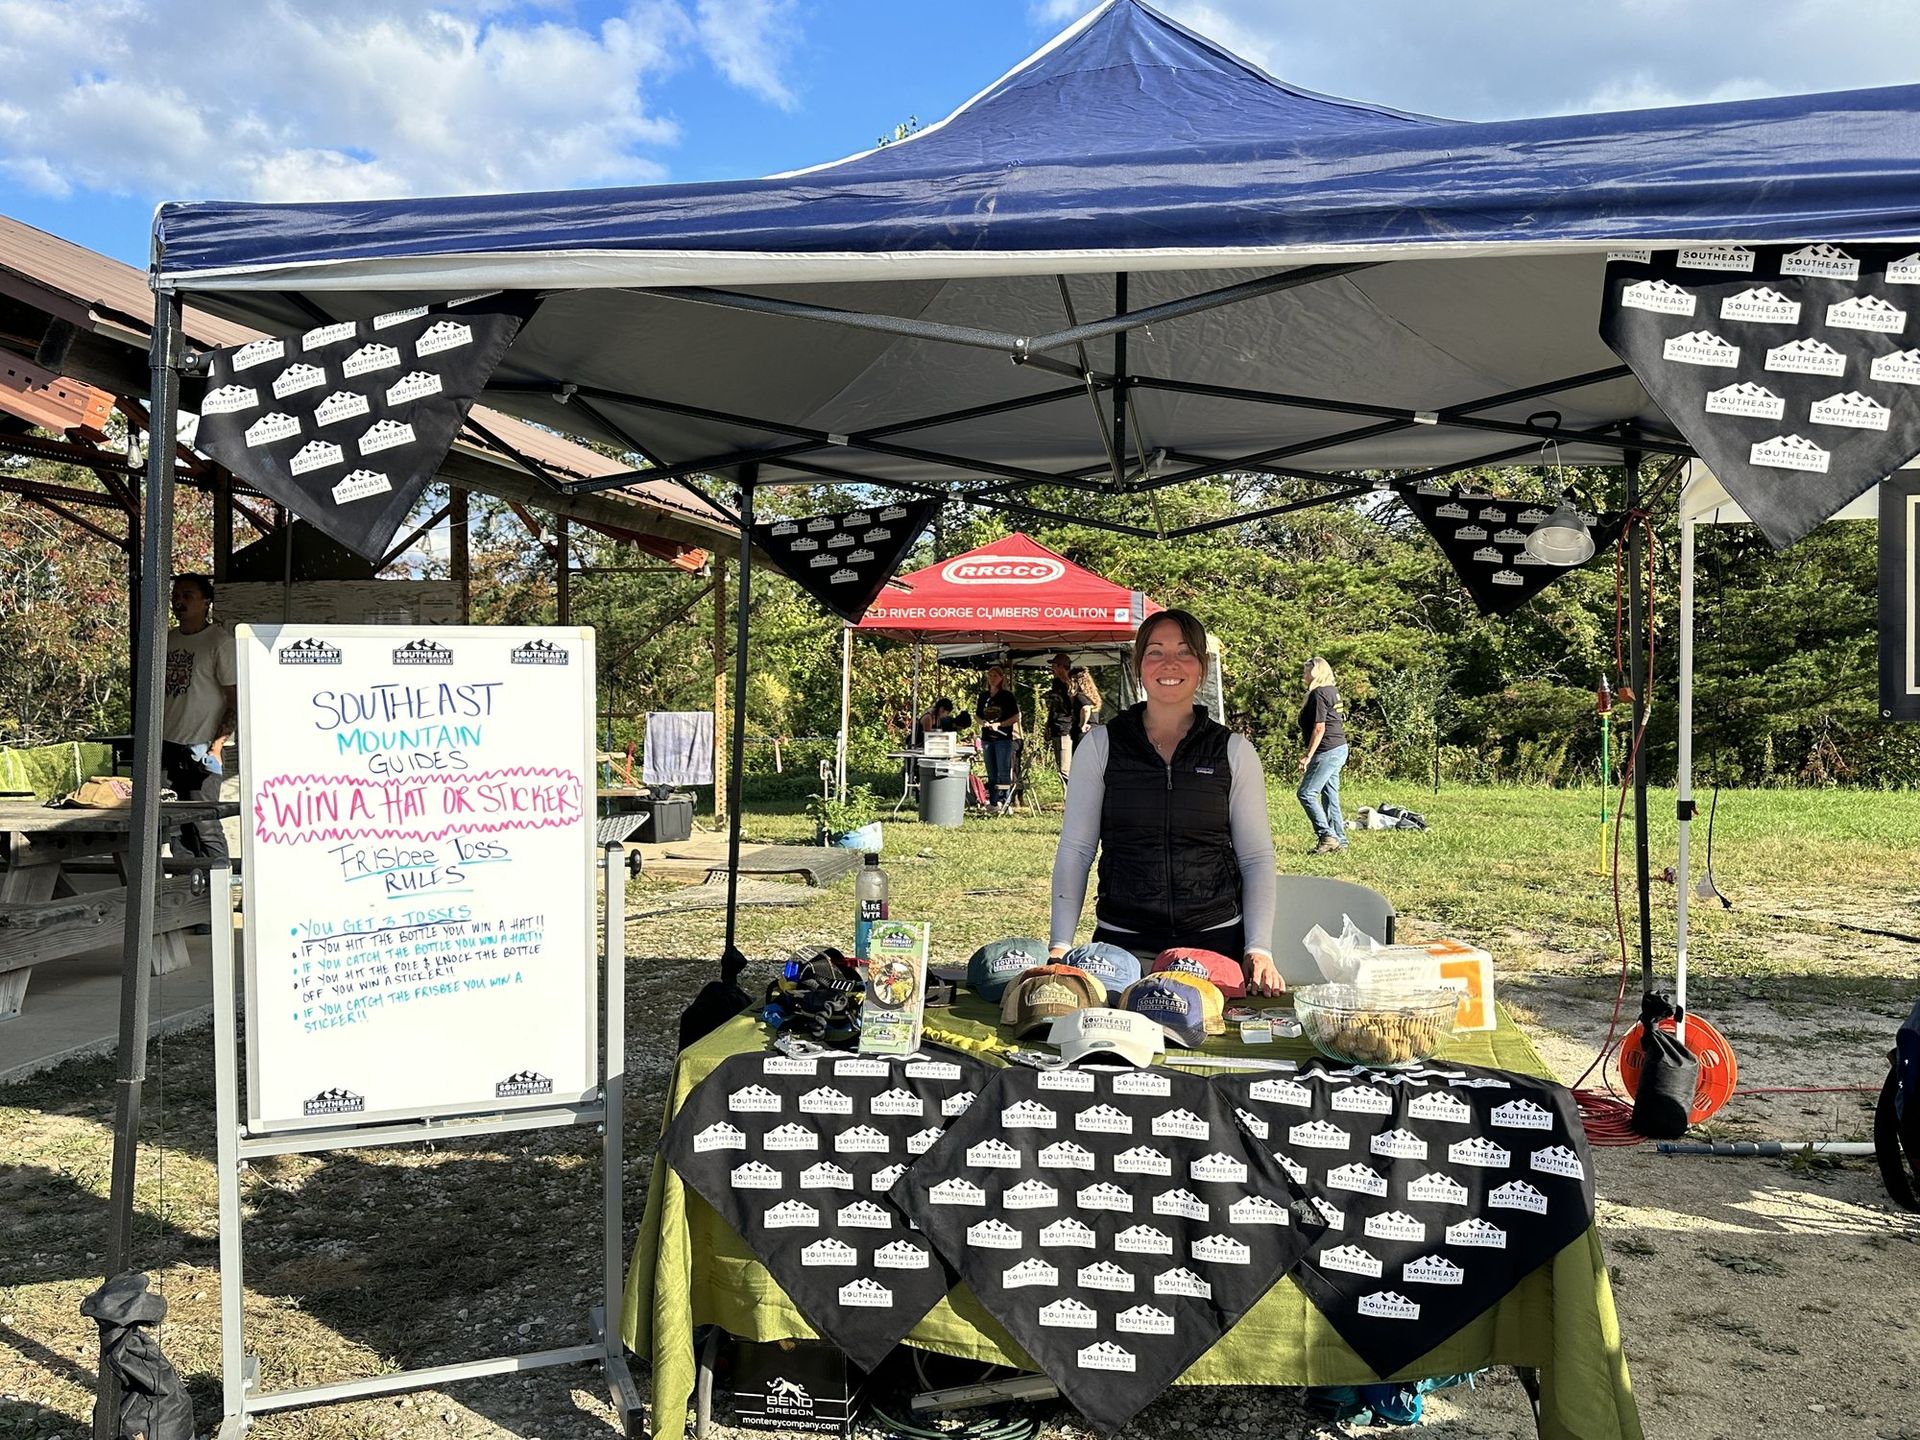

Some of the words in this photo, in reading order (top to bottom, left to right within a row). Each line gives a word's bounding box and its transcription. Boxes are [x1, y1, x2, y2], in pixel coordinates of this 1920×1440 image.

[1683, 251, 1749, 262] SOUTHEAST
[1787, 258, 1854, 270] SOUTHEAST
[1628, 290, 1691, 307] SOUTHEAST
[1728, 302, 1794, 313] SOUTHEAST
[1831, 309, 1900, 324] SOUTHEAST
[307, 323, 351, 341] SOUTHEAST
[420, 329, 468, 348] SOUTHEAST
[1669, 344, 1735, 358] SOUTHEAST
[347, 351, 396, 369] SOUTHEAST
[1772, 354, 1840, 365] SOUTHEAST
[276, 371, 321, 390] SOUTHEAST
[390, 378, 437, 397] SOUTHEAST
[206, 393, 254, 407] SOUTHEAST
[1712, 396, 1779, 409] SOUTHEAST
[318, 399, 365, 417] SOUTHEAST
[1817, 407, 1885, 419] SOUTHEAST
[249, 421, 296, 439] SOUTHEAST
[362, 428, 411, 446] SOUTHEAST
[294, 448, 339, 467] SOUTHEAST
[1756, 448, 1824, 462] SOUTHEAST
[336, 477, 387, 495] SOUTHEAST
[959, 566, 1047, 577] RRGCC
[890, 608, 926, 618] RIVER
[929, 607, 973, 618] GORGE
[1044, 607, 1107, 619] COALITON
[396, 650, 450, 658] SOUTHEAST
[313, 683, 503, 730] SOUTHEAST
[338, 724, 482, 756] MOUNTAIN
[368, 750, 469, 777] GUIDES
[350, 788, 375, 820] A
[379, 786, 427, 826] HAT
[443, 786, 475, 812] OR
[478, 782, 578, 812] STICKER!
[385, 866, 465, 893] RULES
[862, 911, 881, 919] WTR
[300, 919, 333, 940] YOU
[343, 918, 374, 932] GET
[382, 916, 396, 926] 3
[402, 905, 471, 925] TOSSES
[301, 945, 313, 957] IF
[319, 940, 340, 955] YOU
[346, 937, 366, 951] HIT
[371, 933, 393, 945] THE
[400, 927, 437, 942] BOTTLE
[443, 926, 464, 939] YOU
[472, 923, 491, 933] WIN
[499, 920, 505, 931] A
[511, 915, 544, 931] HAT!!
[302, 963, 311, 973] IF
[318, 959, 341, 971] YOU
[346, 951, 381, 966] CATCH
[386, 948, 409, 958] THE
[414, 941, 451, 955] BOTTLE
[455, 938, 476, 950] YOU
[479, 936, 498, 945] WIN
[501, 933, 508, 943] A
[301, 976, 311, 987] IF
[318, 973, 338, 985] YOU
[345, 968, 365, 980] HIT
[369, 965, 389, 975] THE
[395, 961, 419, 972] POLE
[435, 953, 472, 966] KNOCK
[475, 949, 498, 961] THE
[504, 944, 541, 958] BOTTLE
[302, 989, 323, 1003] OFF
[332, 984, 354, 996] YOU
[359, 979, 380, 990] WIN
[385, 976, 392, 986] A
[395, 966, 455, 983] STICKER!!
[304, 1008, 313, 1018] IF
[319, 1003, 342, 1016] YOU
[346, 994, 384, 1011] CATCH
[387, 991, 410, 1004] THE
[414, 980, 461, 999] FRISBEE
[463, 978, 485, 991] YOU
[489, 973, 511, 986] WIN
[515, 971, 523, 984] A
[1140, 999, 1186, 1010] SOUTHEAST
[304, 1010, 368, 1033] STICKER!!
[1084, 1017, 1129, 1025] SOUTHEAST
[498, 1082, 551, 1091] SOUTHEAST
[307, 1099, 362, 1108] SOUTHEAST
[803, 1099, 848, 1107] SOUTHEAST
[875, 1100, 920, 1108] SOUTHEAST
[1336, 1097, 1388, 1107] SOUTHEAST
[1413, 1104, 1466, 1115] SOUTHEAST
[1495, 1112, 1549, 1122] SOUTHEAST
[1156, 1121, 1205, 1132] SOUTHEAST
[698, 1134, 742, 1144] SOUTHEAST
[1375, 1140, 1423, 1153] SOUTHEAST
[1043, 1153, 1090, 1162] SOUTHEAST
[1453, 1149, 1506, 1160] SOUTHEAST
[1118, 1157, 1167, 1168] SOUTHEAST
[1493, 1192, 1543, 1205] SOUTHEAST
[842, 1212, 887, 1221] SOUTHEAST
[1450, 1231, 1502, 1240] SOUTHEAST
[1196, 1246, 1246, 1257] SOUTHEAST
[1082, 1273, 1130, 1284] SOUTHEAST
[843, 1291, 888, 1299] SOUTHEAST
[1363, 1301, 1416, 1312] SOUTHEAST
[1120, 1317, 1170, 1327] SOUTHEAST
[1082, 1354, 1132, 1364] SOUTHEAST
[766, 1396, 813, 1408] BEND
[767, 1407, 814, 1416] OREGON
[742, 1416, 840, 1431] montereycompany.com
